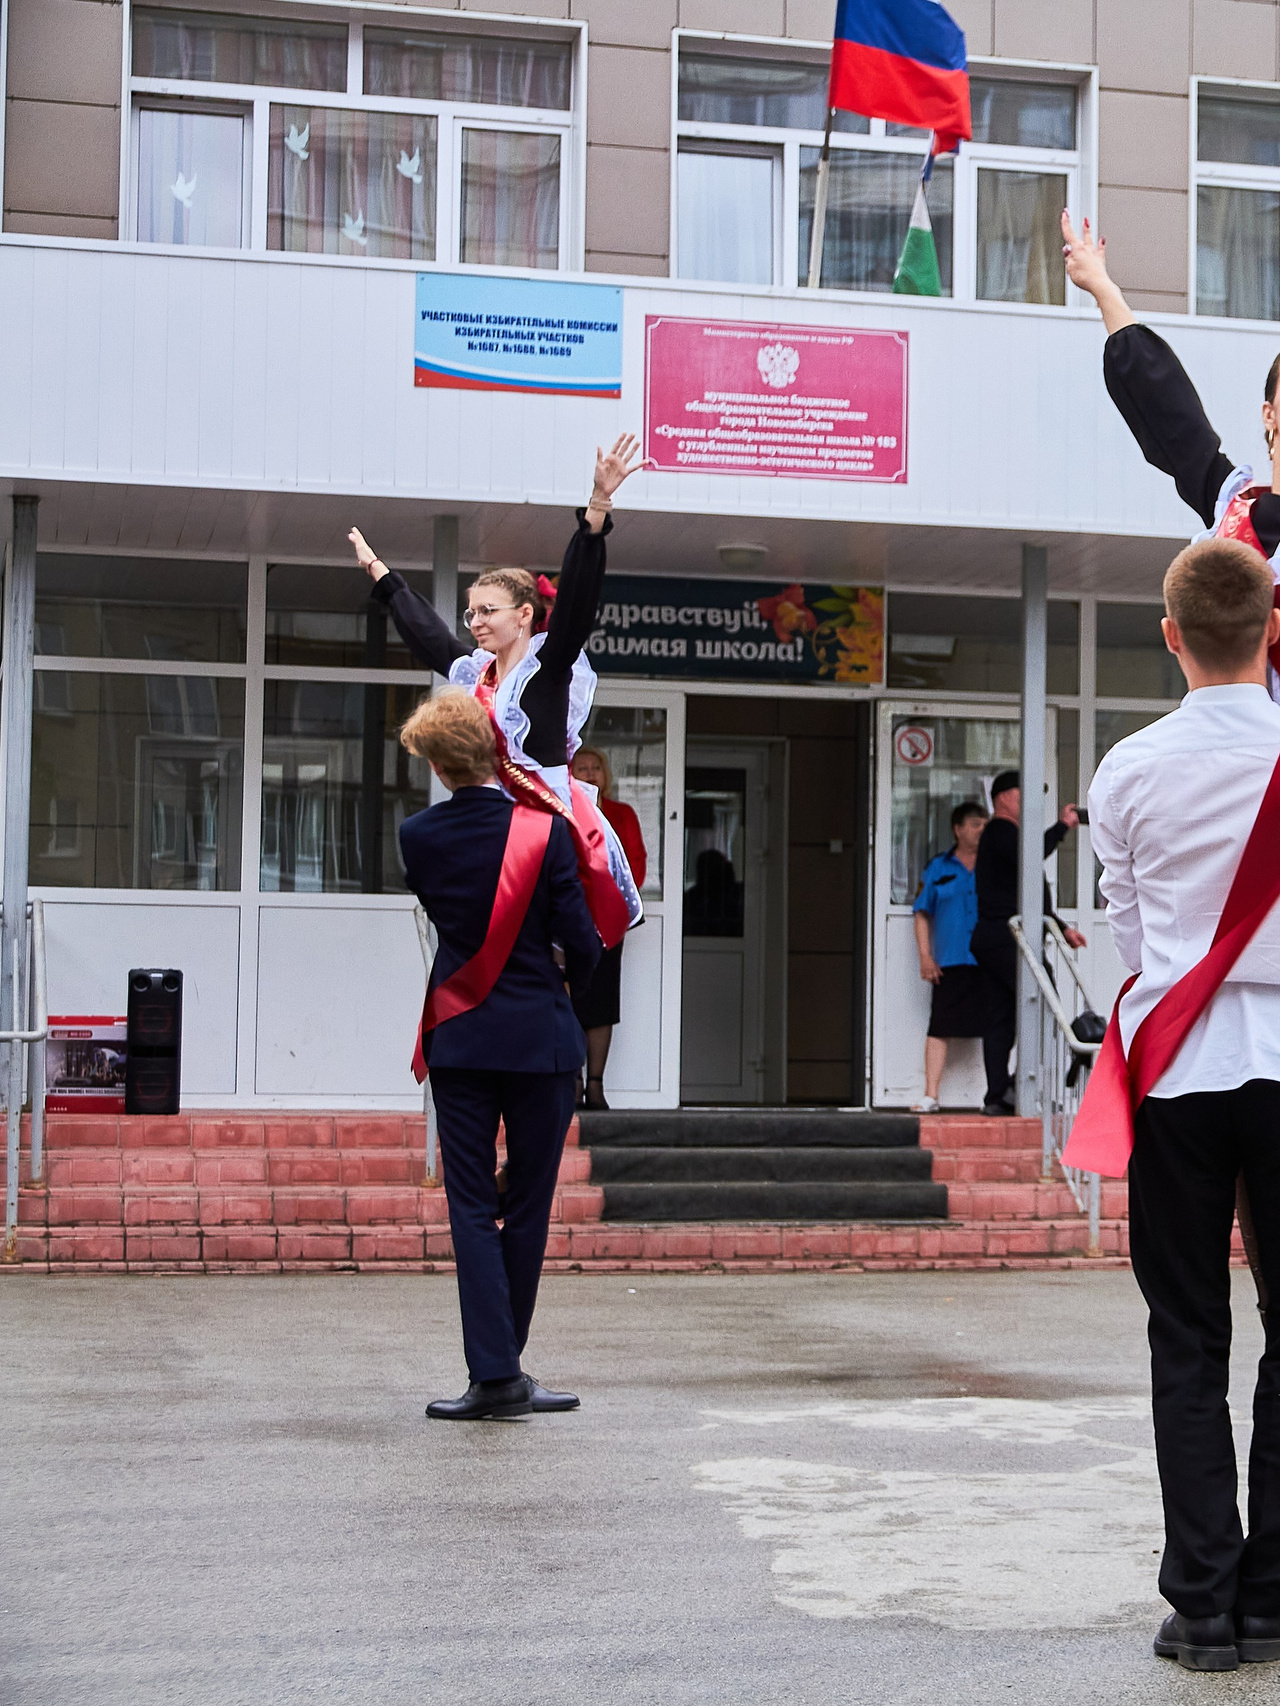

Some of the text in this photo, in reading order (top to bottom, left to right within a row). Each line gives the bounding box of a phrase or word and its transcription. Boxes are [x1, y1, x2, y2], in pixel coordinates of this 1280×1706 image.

[421, 310, 618, 333] УЧАСТКОВЫЕ ИЗБИРАТЕЛЬНЫЕ КОМИССИИ
[455, 327, 584, 344] ИЗБИРАТЕЛЬНЫХ УЧАСТКОВ
[704, 391, 850, 409] муниципальное бюджетное
[685, 400, 868, 422] общеобразовательное учреждение
[720, 415, 833, 432] города Новосибирска
[707, 425, 825, 445] общеобразовательная
[826, 434, 861, 446] школа
[818, 447, 874, 461] предметов
[596, 600, 768, 633] дравствуй,
[584, 628, 804, 663] бимая школа!
